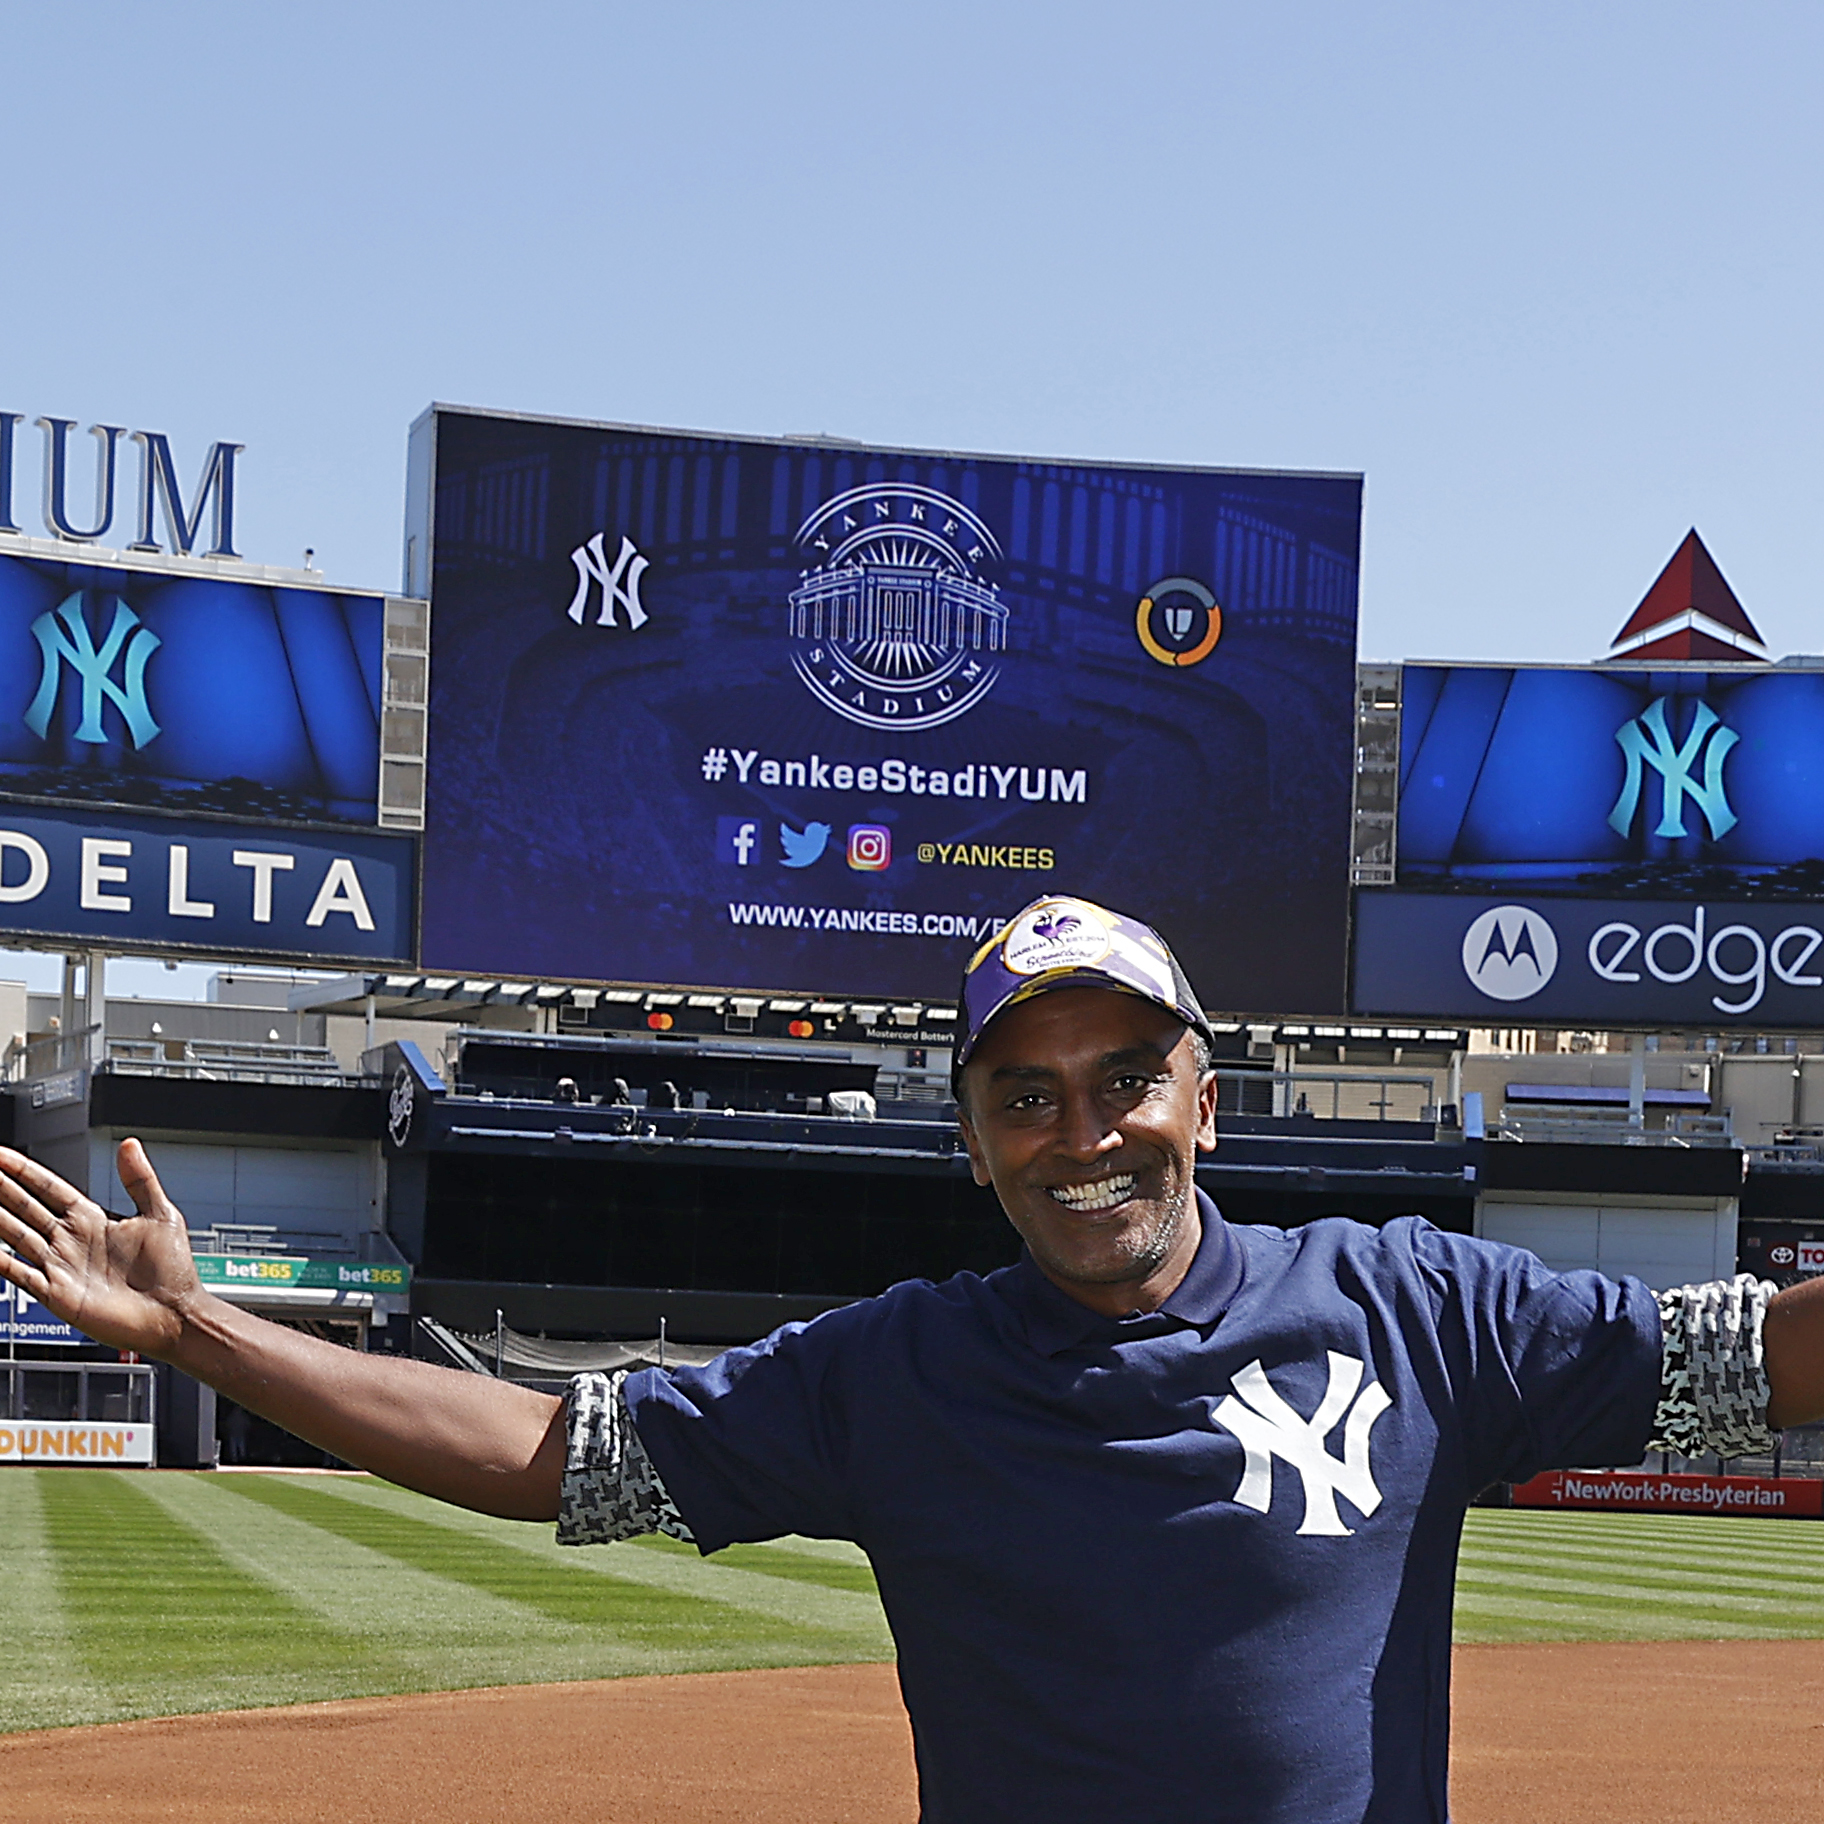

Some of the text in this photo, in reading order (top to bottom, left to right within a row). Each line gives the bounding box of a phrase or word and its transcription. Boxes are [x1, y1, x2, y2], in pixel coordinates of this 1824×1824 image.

[814, 501, 984, 564] YANKEE
[809, 648, 982, 714] STADIUM
[702, 747, 1088, 803] #YankeeStadiYUM
[918, 842, 1055, 870] @YANKEES
[1588, 905, 1824, 1015] edge
[226, 1260, 292, 1280] bet365
[338, 1266, 403, 1285] bet365
